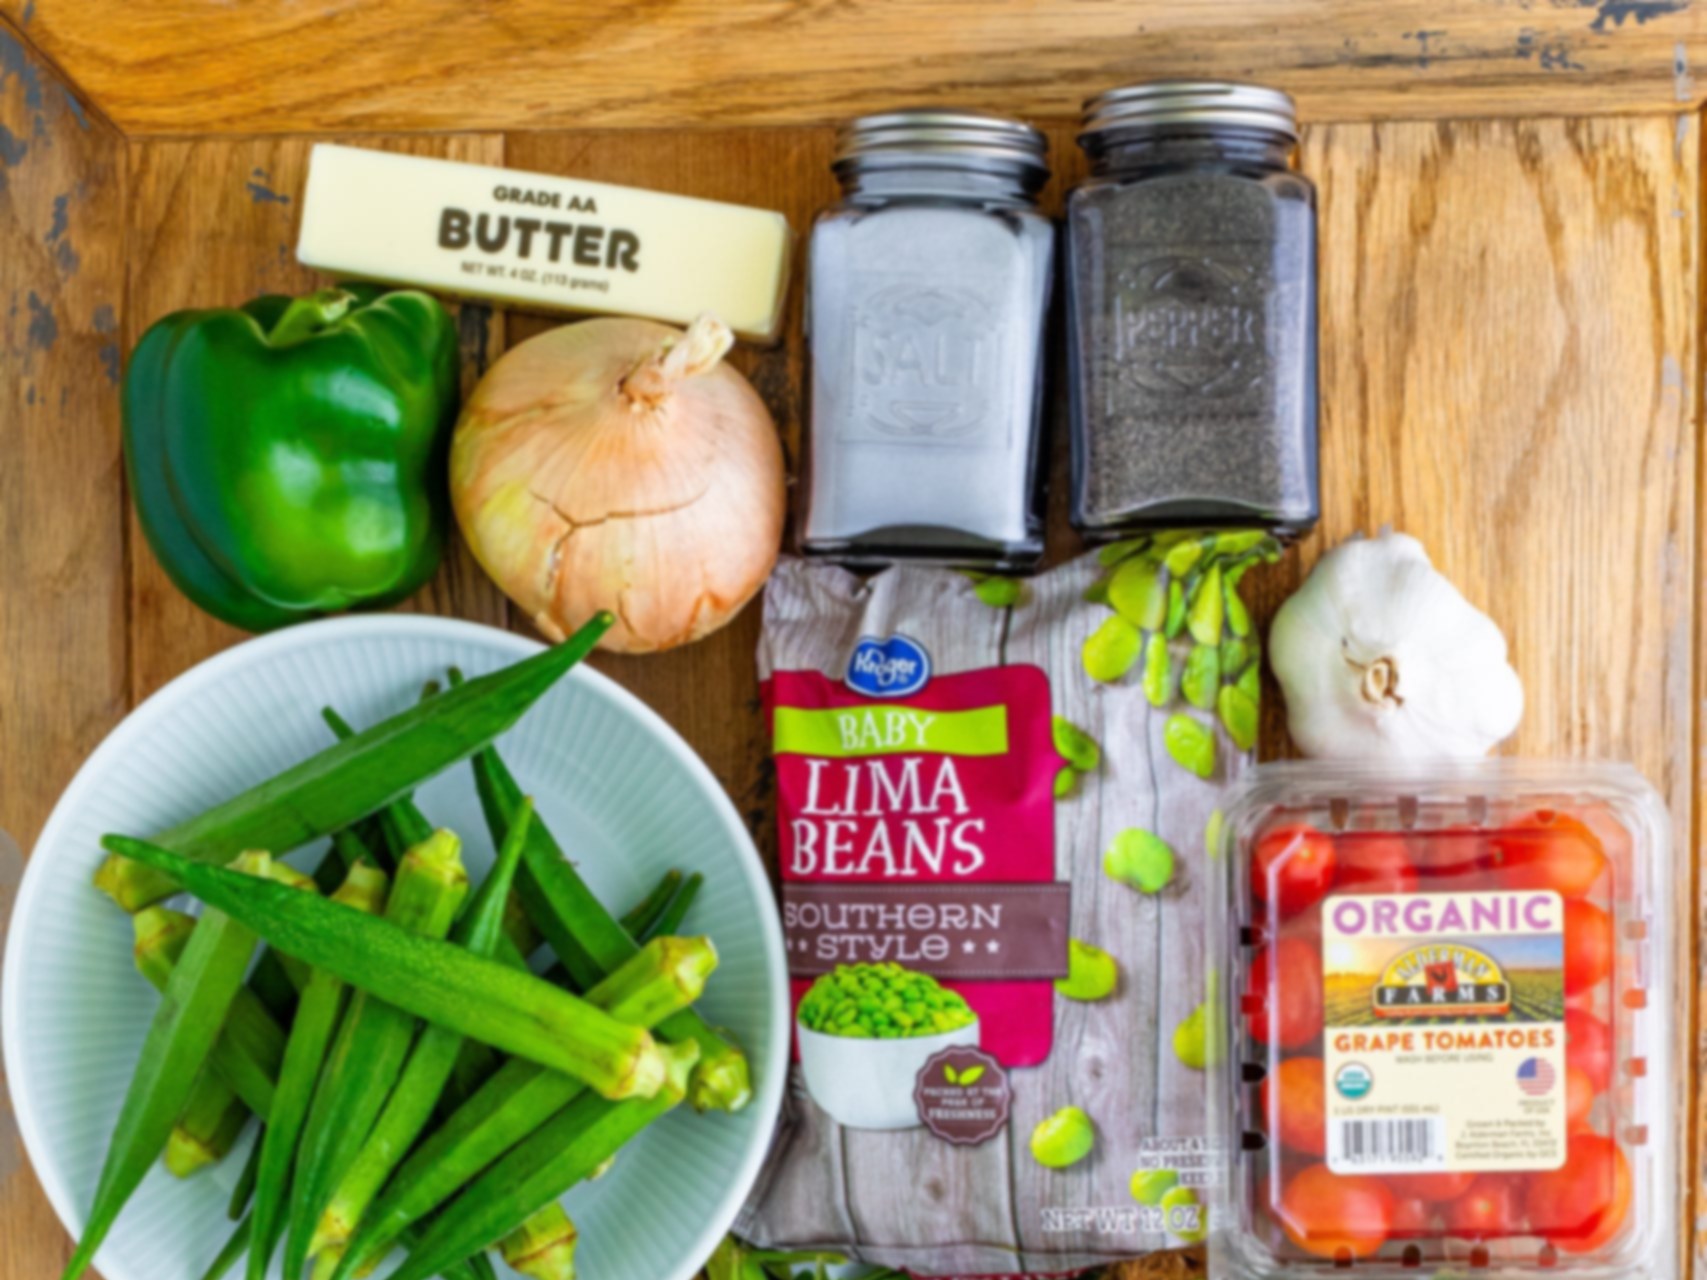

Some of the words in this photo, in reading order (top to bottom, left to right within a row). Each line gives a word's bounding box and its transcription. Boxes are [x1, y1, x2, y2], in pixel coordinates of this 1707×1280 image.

[493, 185, 561, 208] GRADE
[567, 195, 597, 213] AA
[438, 206, 640, 274] BUTTER
[461, 261, 483, 275] NET
[510, 268, 518, 279] 4
[861, 327, 988, 388] SALT
[855, 648, 917, 687] Kroger
[836, 710, 938, 750] BABY
[800, 756, 970, 817] LIMA
[790, 816, 986, 877] BEANS
[784, 901, 1003, 931] SOUTHERN
[1333, 896, 1552, 935] ORGANIC
[815, 933, 951, 961] STYLE
[1384, 984, 1500, 1005] FARMS
[1334, 1032, 1415, 1053] GRAPE
[1423, 1029, 1556, 1050] TOMATOES
[1041, 1206, 1092, 1232] NET
[1096, 1206, 1138, 1233] WT
[1141, 1206, 1165, 1231] 12
[1170, 1206, 1199, 1230] OZ
